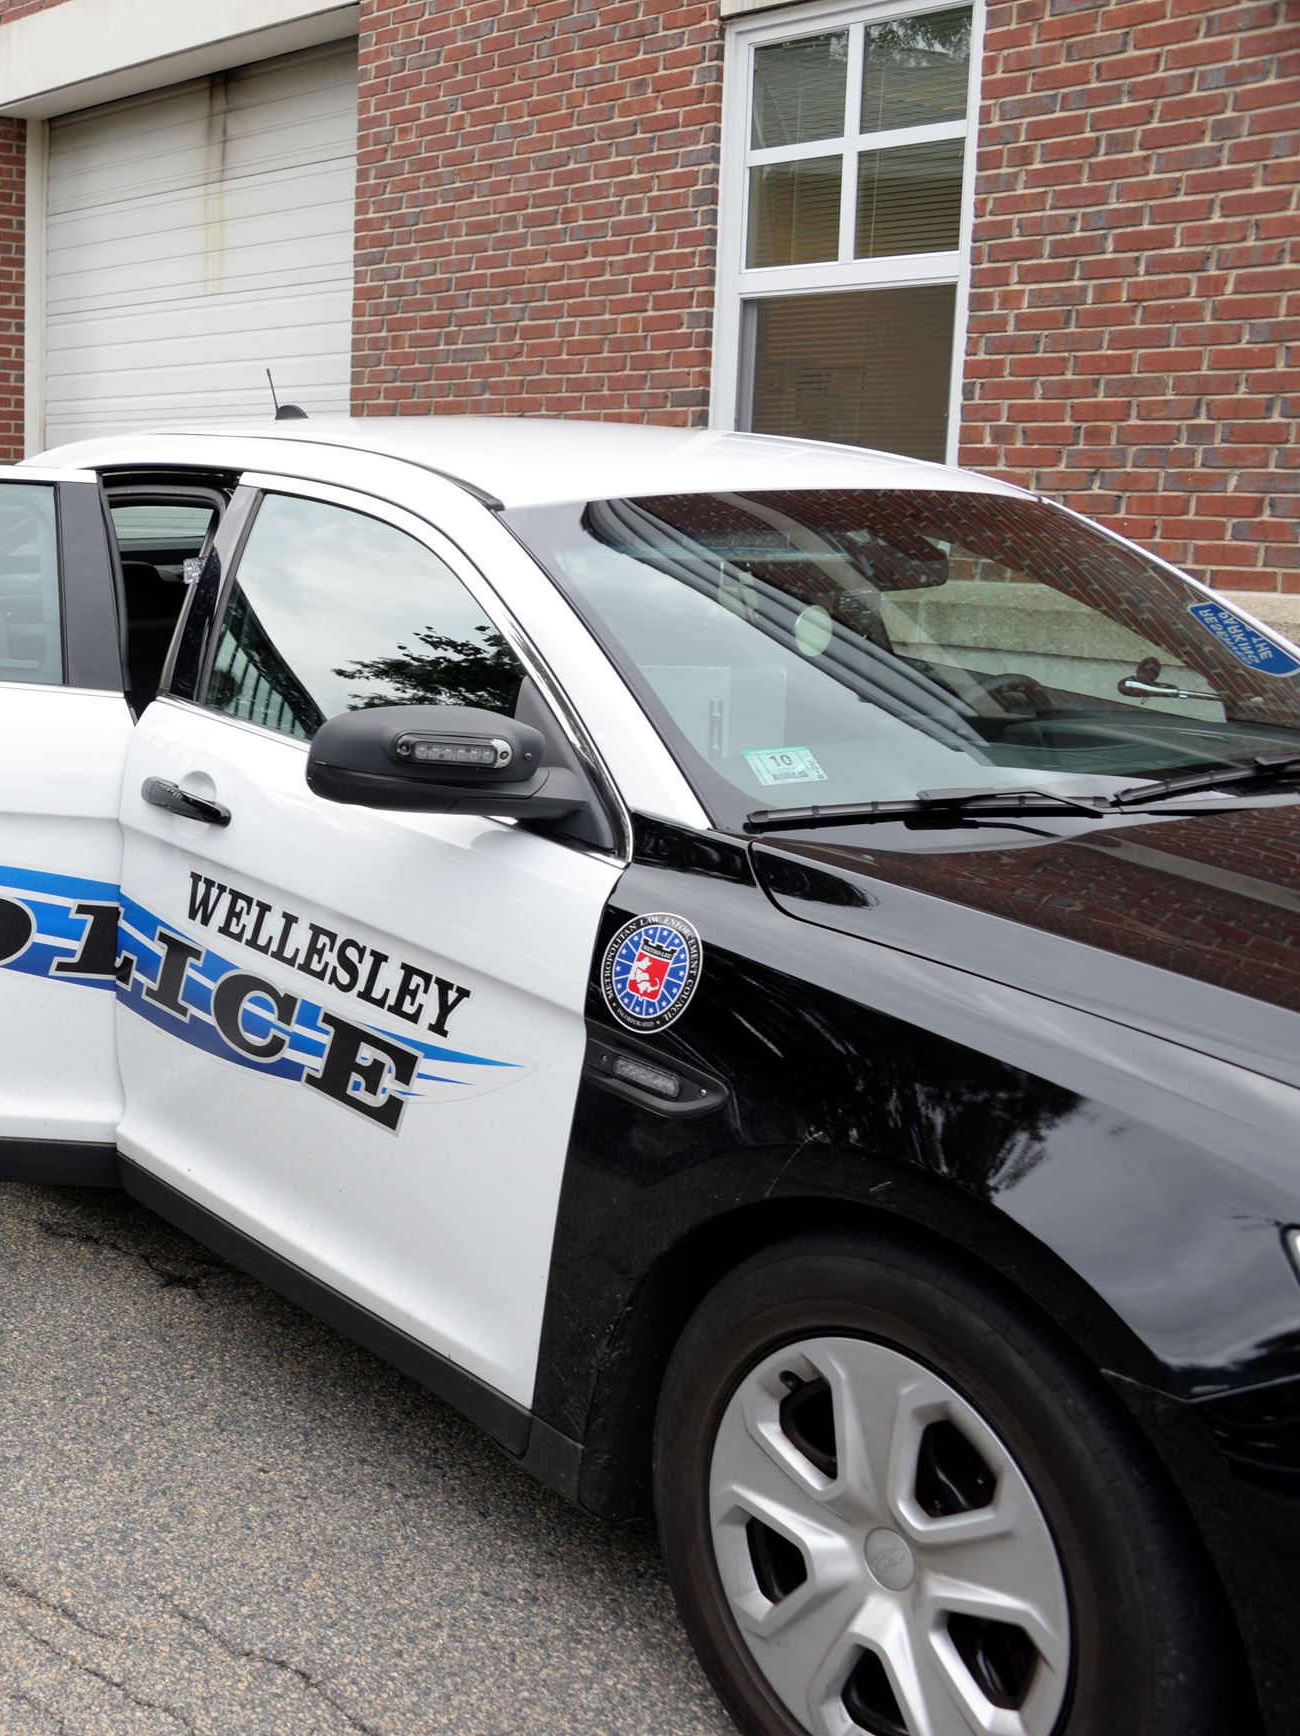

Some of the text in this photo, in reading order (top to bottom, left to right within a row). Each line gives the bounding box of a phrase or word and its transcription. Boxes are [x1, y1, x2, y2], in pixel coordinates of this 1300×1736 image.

[769, 754, 793, 767] 10
[188, 871, 471, 1039] WELLESLEY
[604, 916, 697, 1021] METROPOLITAN LAW ENFORCEMENT COUNCIL
